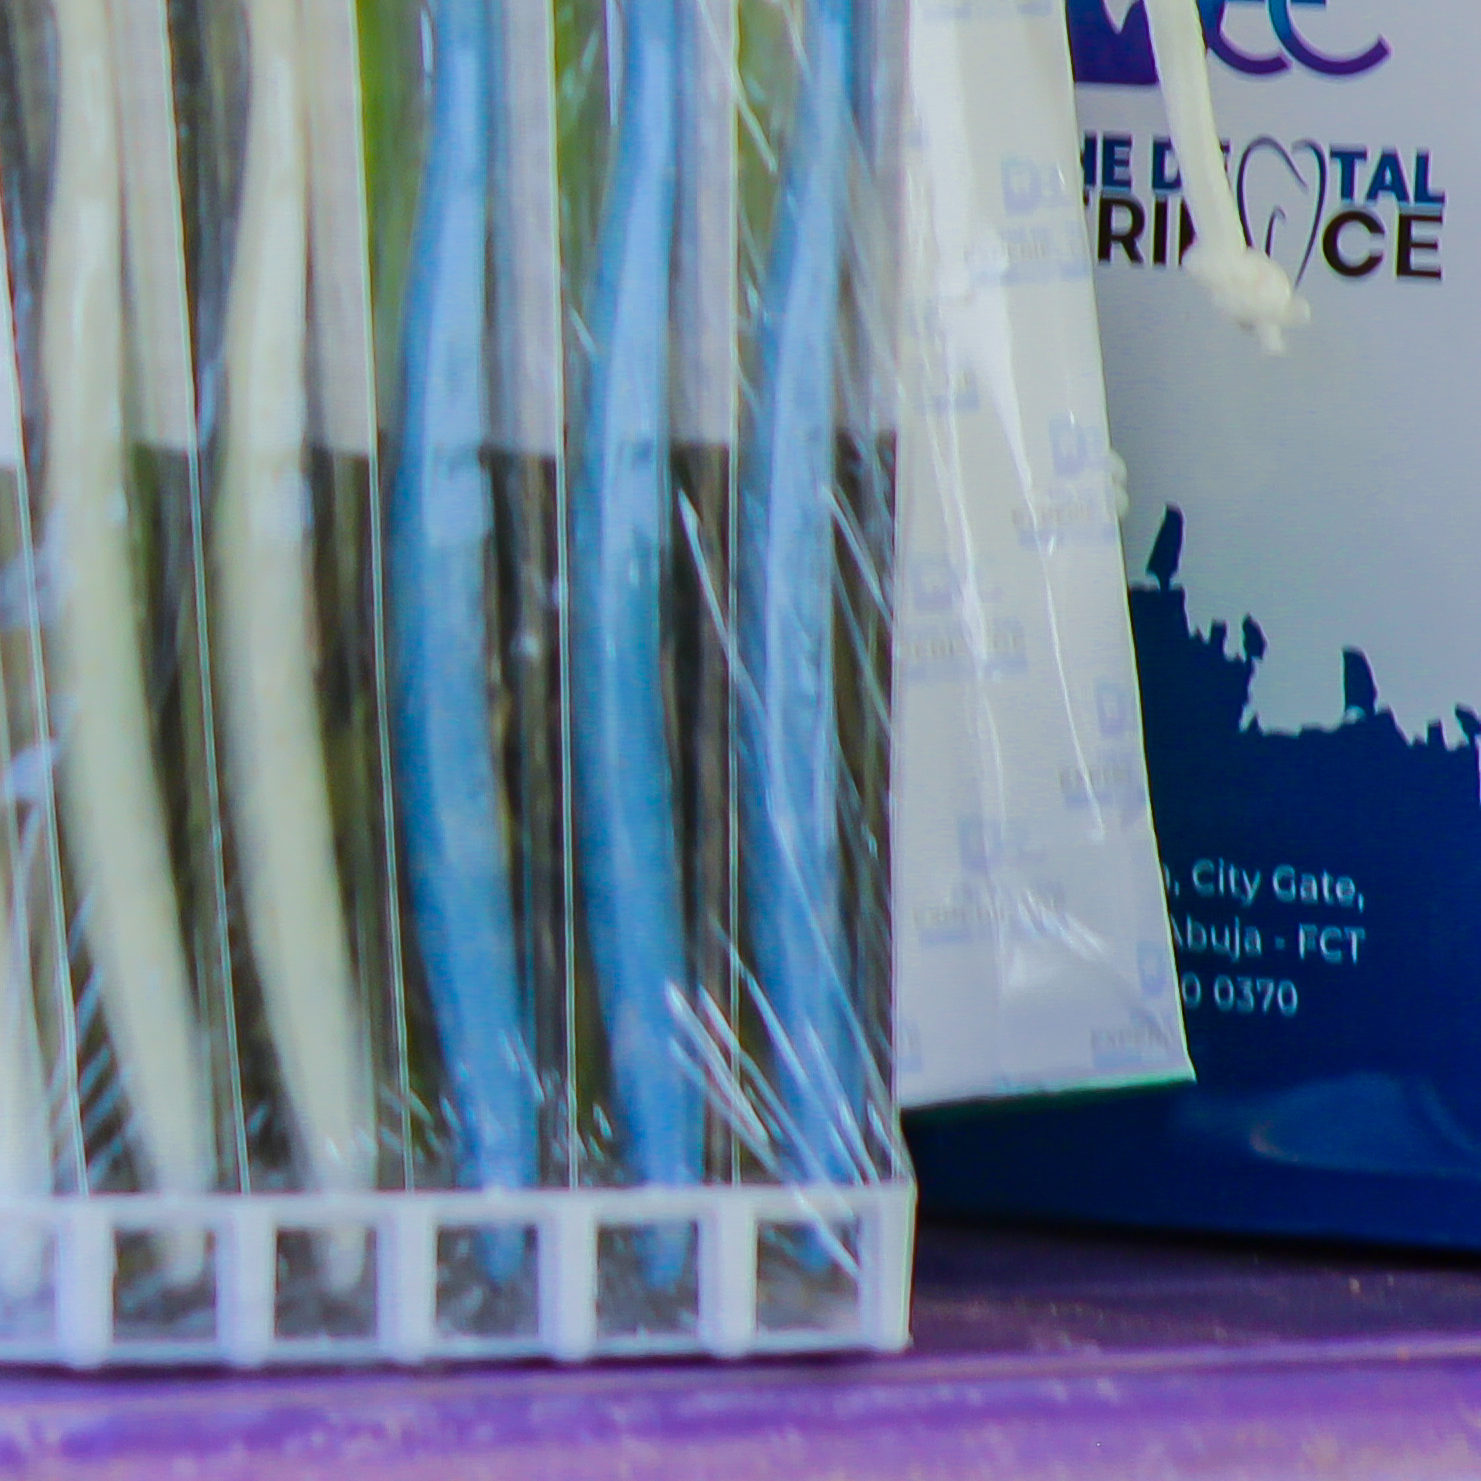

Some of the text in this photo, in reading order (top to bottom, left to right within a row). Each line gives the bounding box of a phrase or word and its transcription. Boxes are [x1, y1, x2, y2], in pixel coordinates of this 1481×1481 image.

[1191, 857, 1261, 907] City
[1272, 863, 1365, 913] Gate,
[1299, 922, 1366, 966] FCT
[1213, 973, 1299, 1017] 0370
